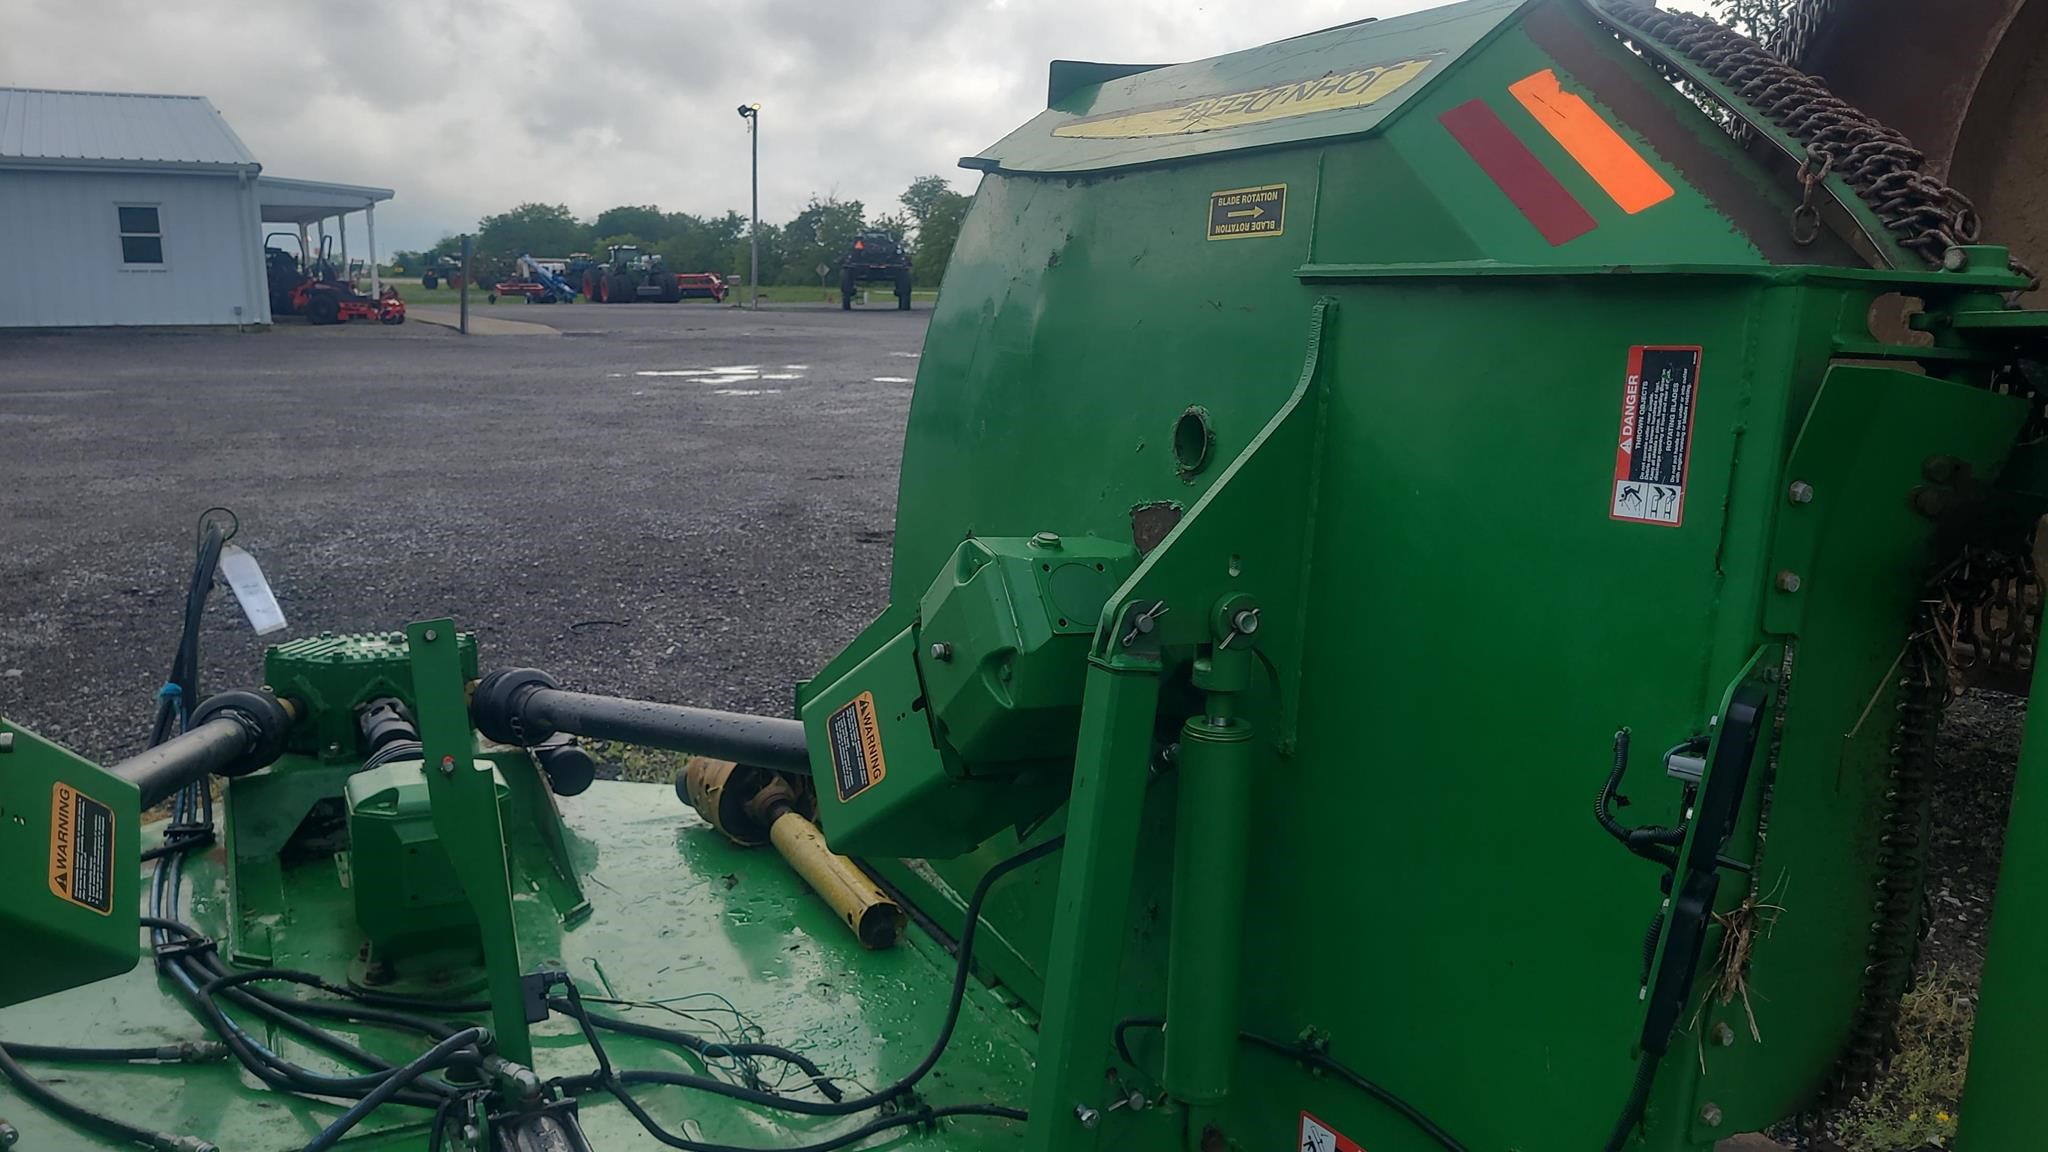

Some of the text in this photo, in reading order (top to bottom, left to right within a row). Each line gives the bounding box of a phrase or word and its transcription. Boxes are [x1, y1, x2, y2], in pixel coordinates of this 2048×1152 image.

[1168, 65, 1403, 122] JOHN DEERE
[1215, 220, 1275, 234] BLADE ROTATION
[1218, 191, 1278, 207] BLADE ROTATION
[1622, 375, 1639, 436] DANGER
[1635, 381, 1648, 449] THROWN OBJECTS
[1665, 382, 1679, 451] ROTATING BLADES
[862, 713, 882, 780] WARNING
[56, 787, 70, 870] WARNING
